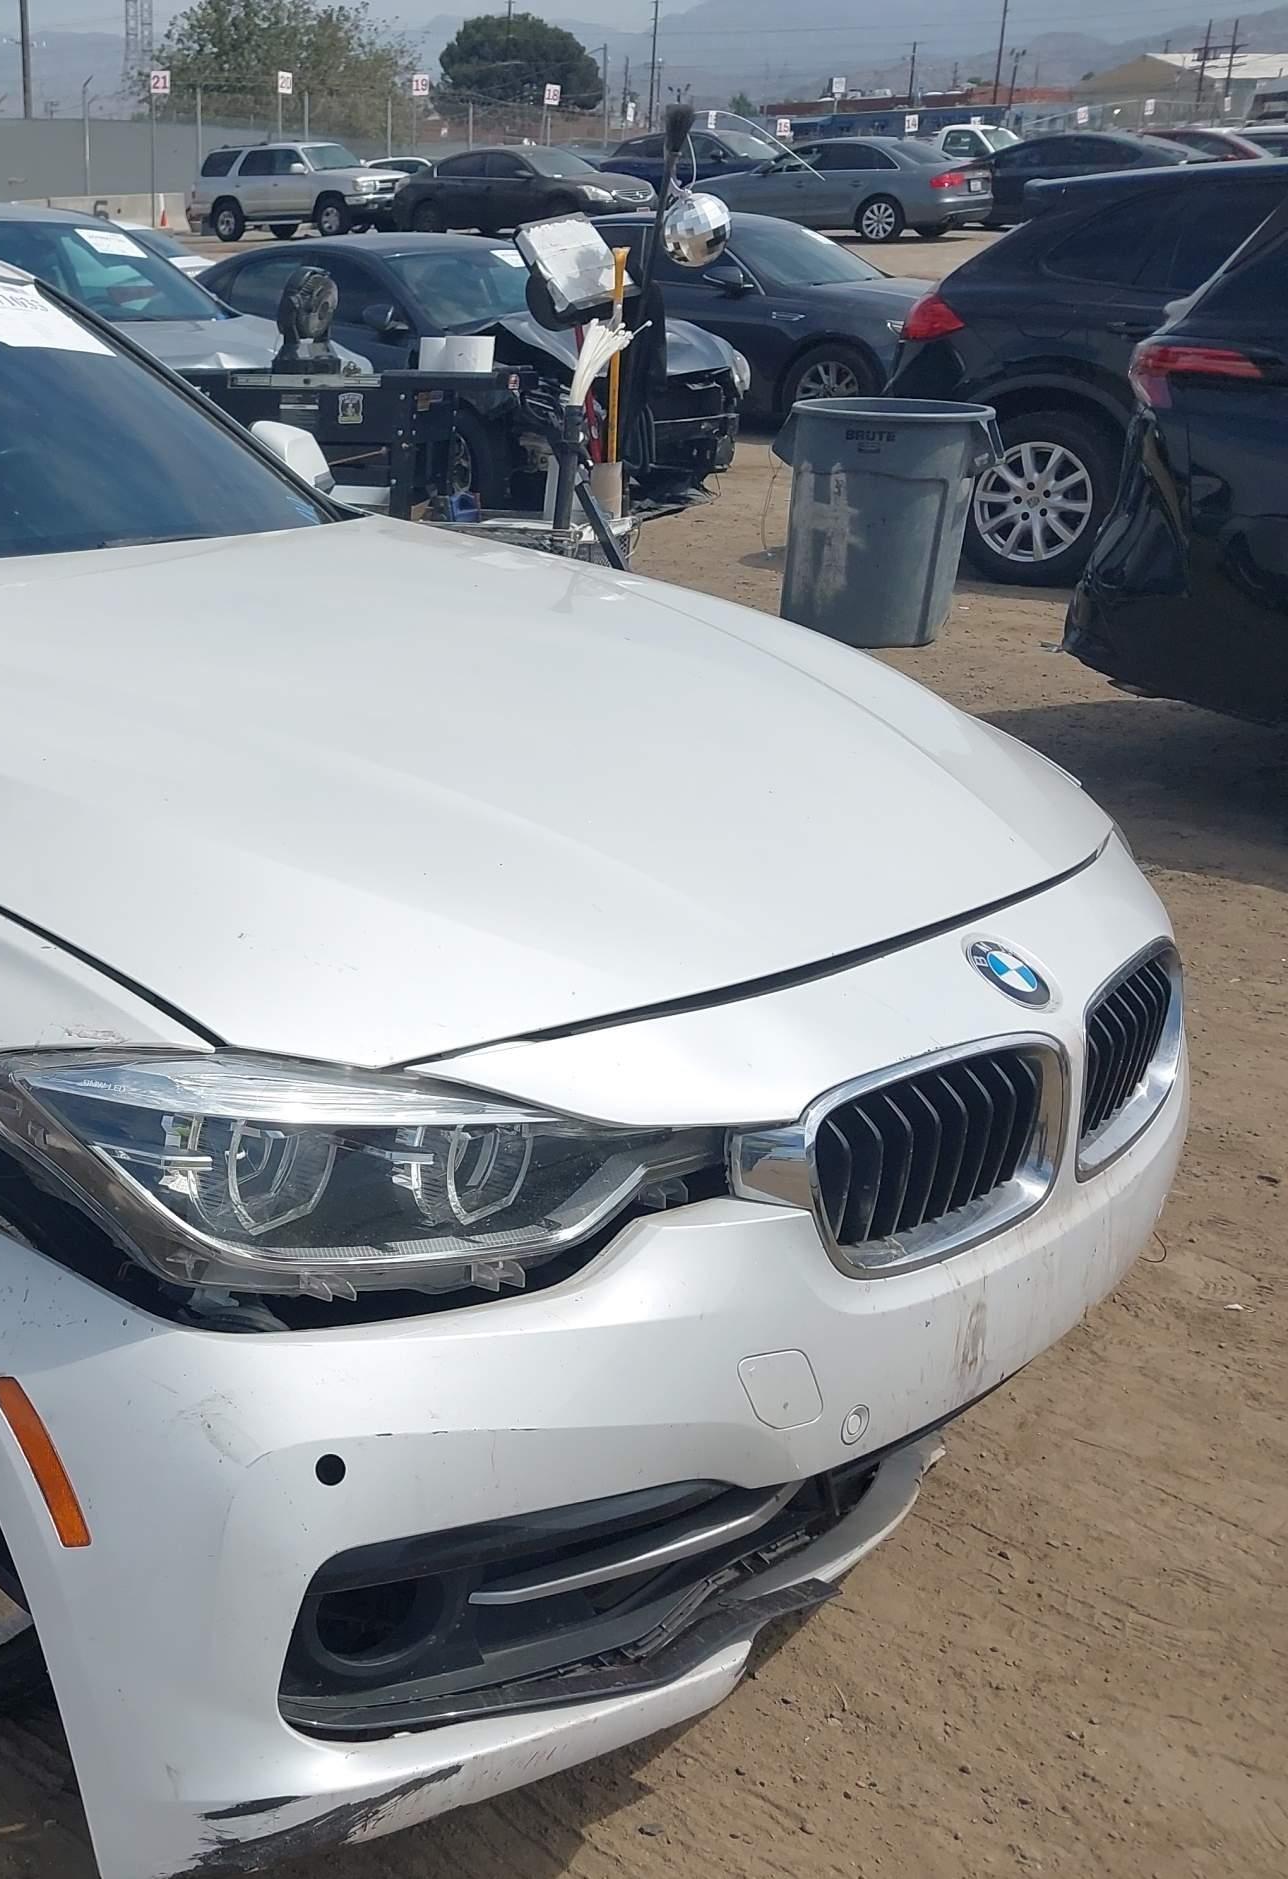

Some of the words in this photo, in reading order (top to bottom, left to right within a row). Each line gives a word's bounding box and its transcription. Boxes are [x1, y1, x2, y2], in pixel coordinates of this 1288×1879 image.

[151, 75, 168, 90] 21
[279, 75, 292, 90] 20
[413, 78, 428, 92] 19
[545, 88, 559, 101] 18
[777, 121, 790, 133] 15
[905, 116, 918, 129] 14
[846, 430, 896, 442] BRUTE
